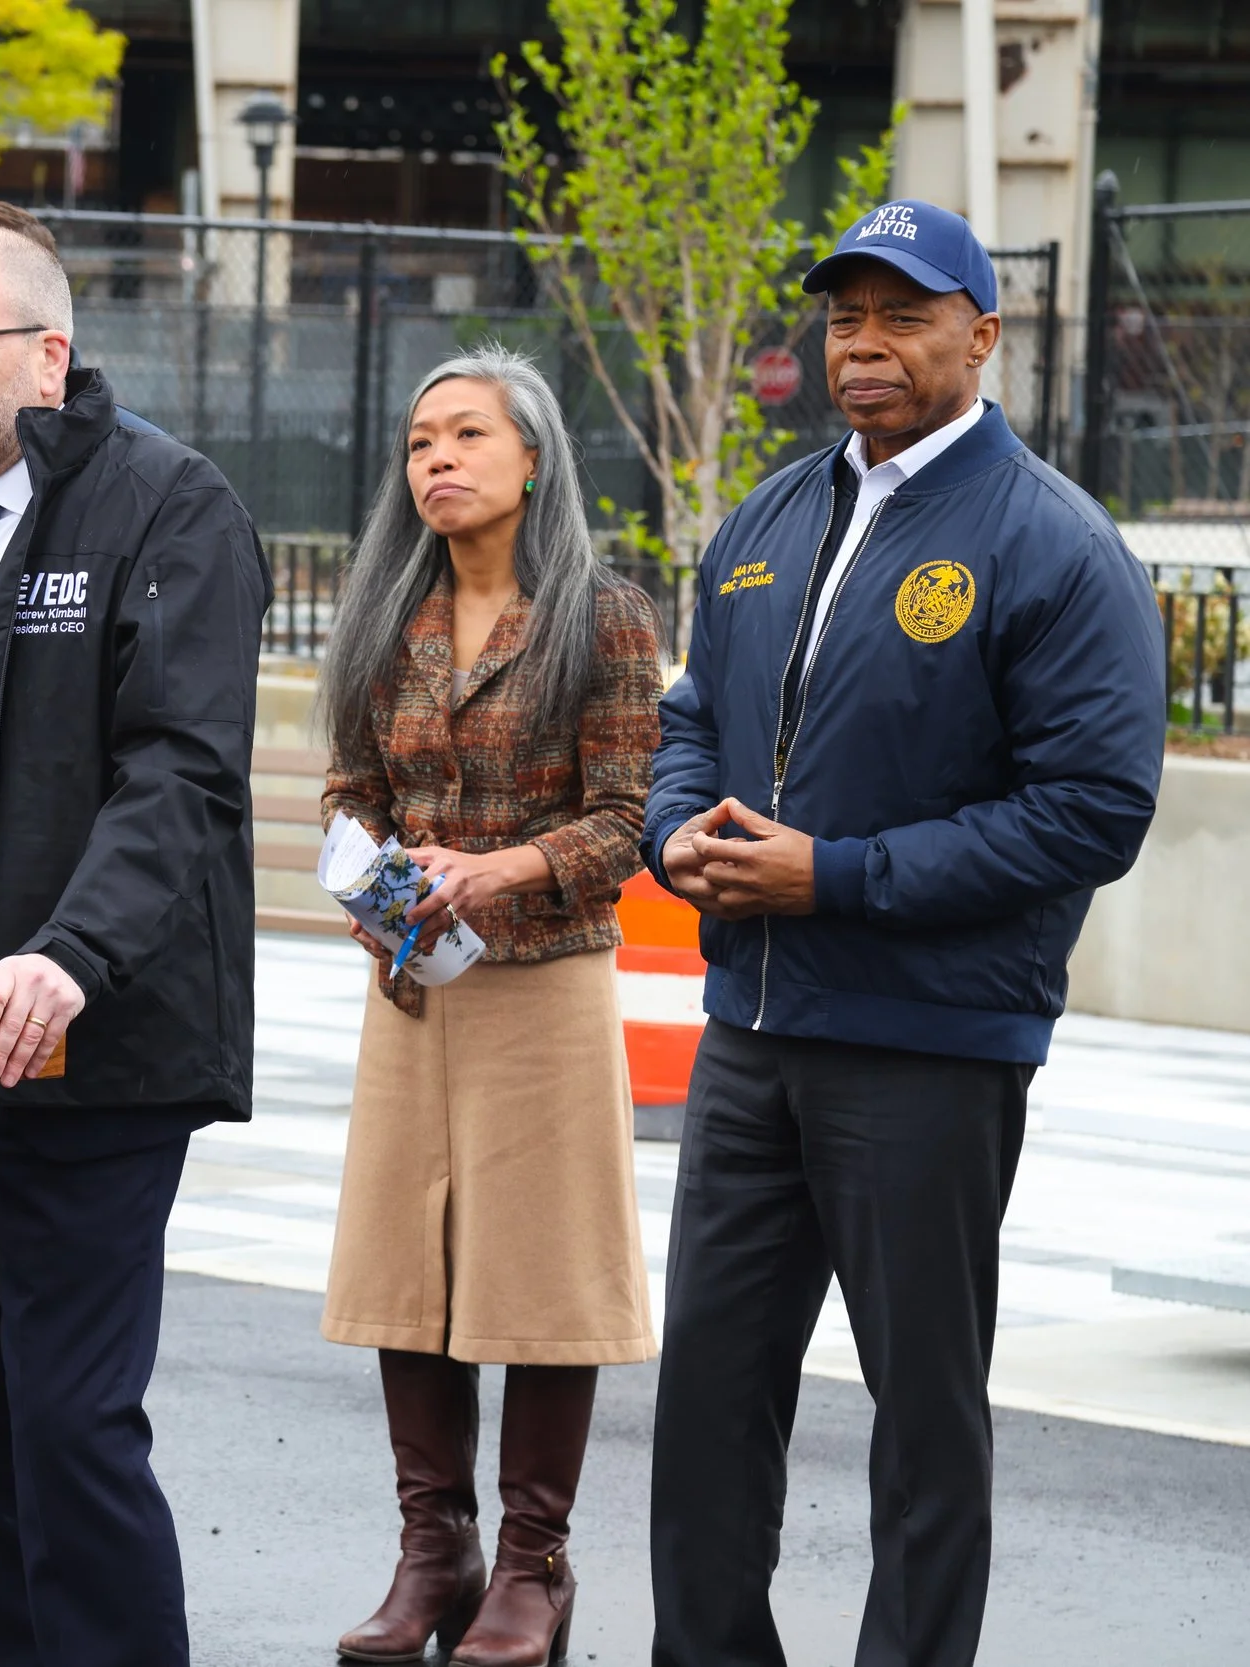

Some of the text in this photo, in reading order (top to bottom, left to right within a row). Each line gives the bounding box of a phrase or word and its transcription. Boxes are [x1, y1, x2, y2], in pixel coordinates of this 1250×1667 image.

[873, 206, 914, 223] NYC
[855, 220, 918, 241] MAYOR
[732, 561, 767, 578] MAYOR
[739, 573, 775, 589] ADAMS
[15, 607, 87, 620] ndrew Kimball
[13, 621, 85, 634] resident & CEO
